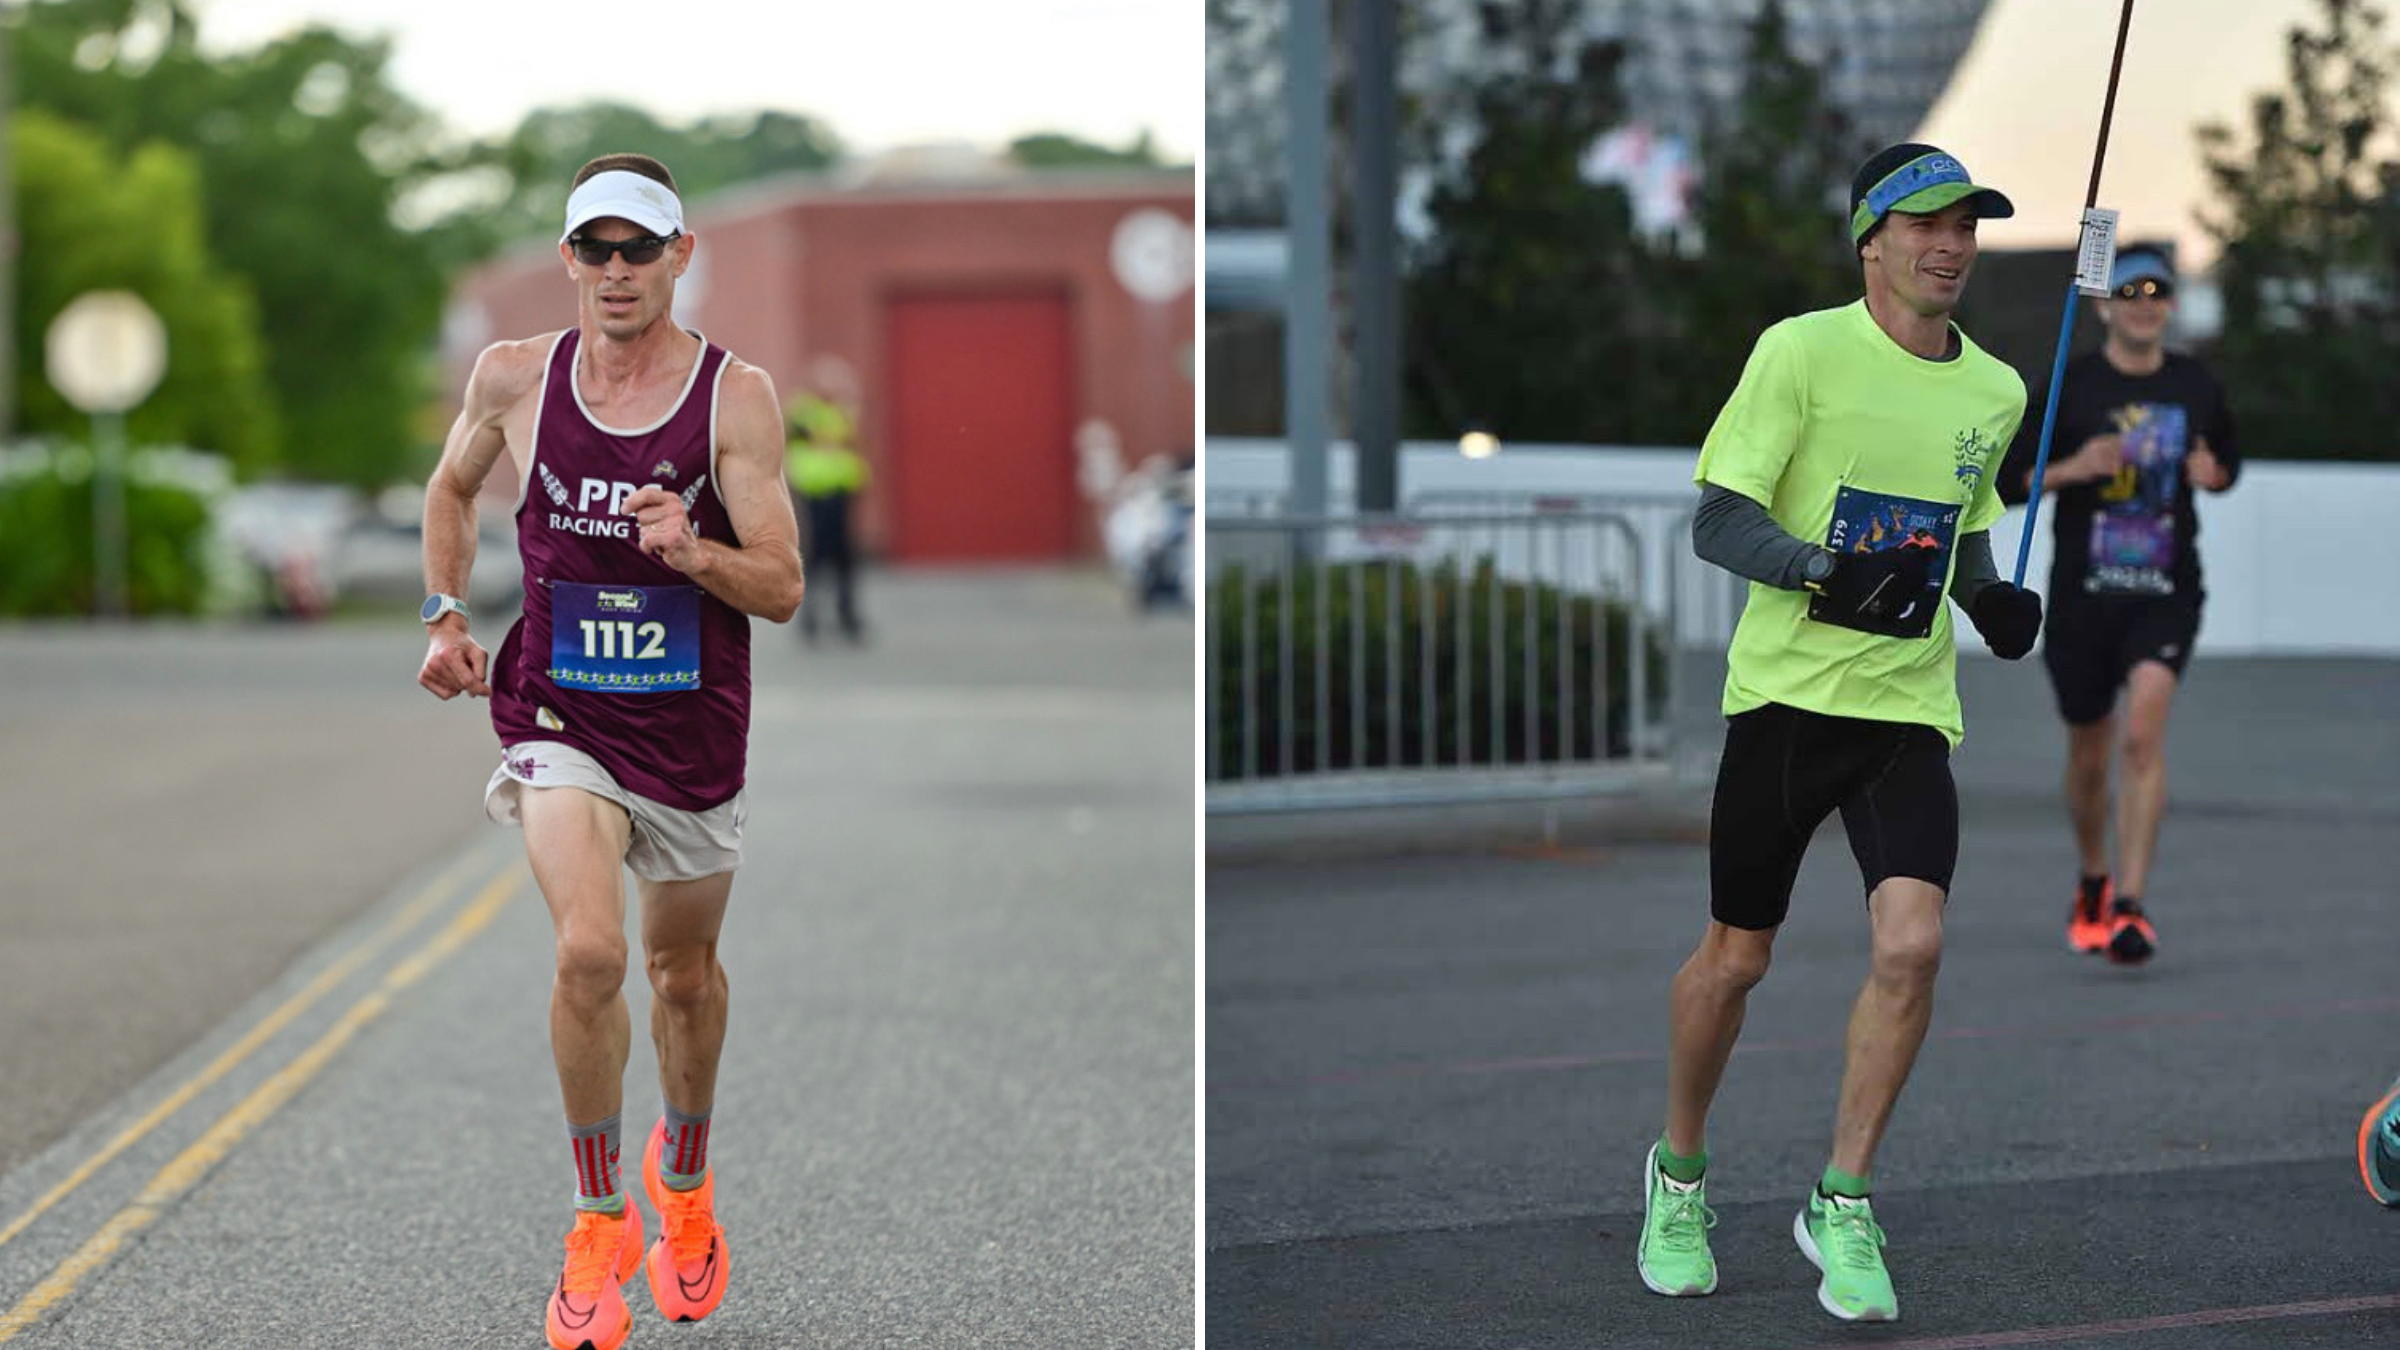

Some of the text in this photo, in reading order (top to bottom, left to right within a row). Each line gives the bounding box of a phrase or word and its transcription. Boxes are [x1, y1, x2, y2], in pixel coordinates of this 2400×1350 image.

[578, 477, 662, 517] PR
[549, 513, 630, 539] RACING
[579, 619, 666, 660] 1112
